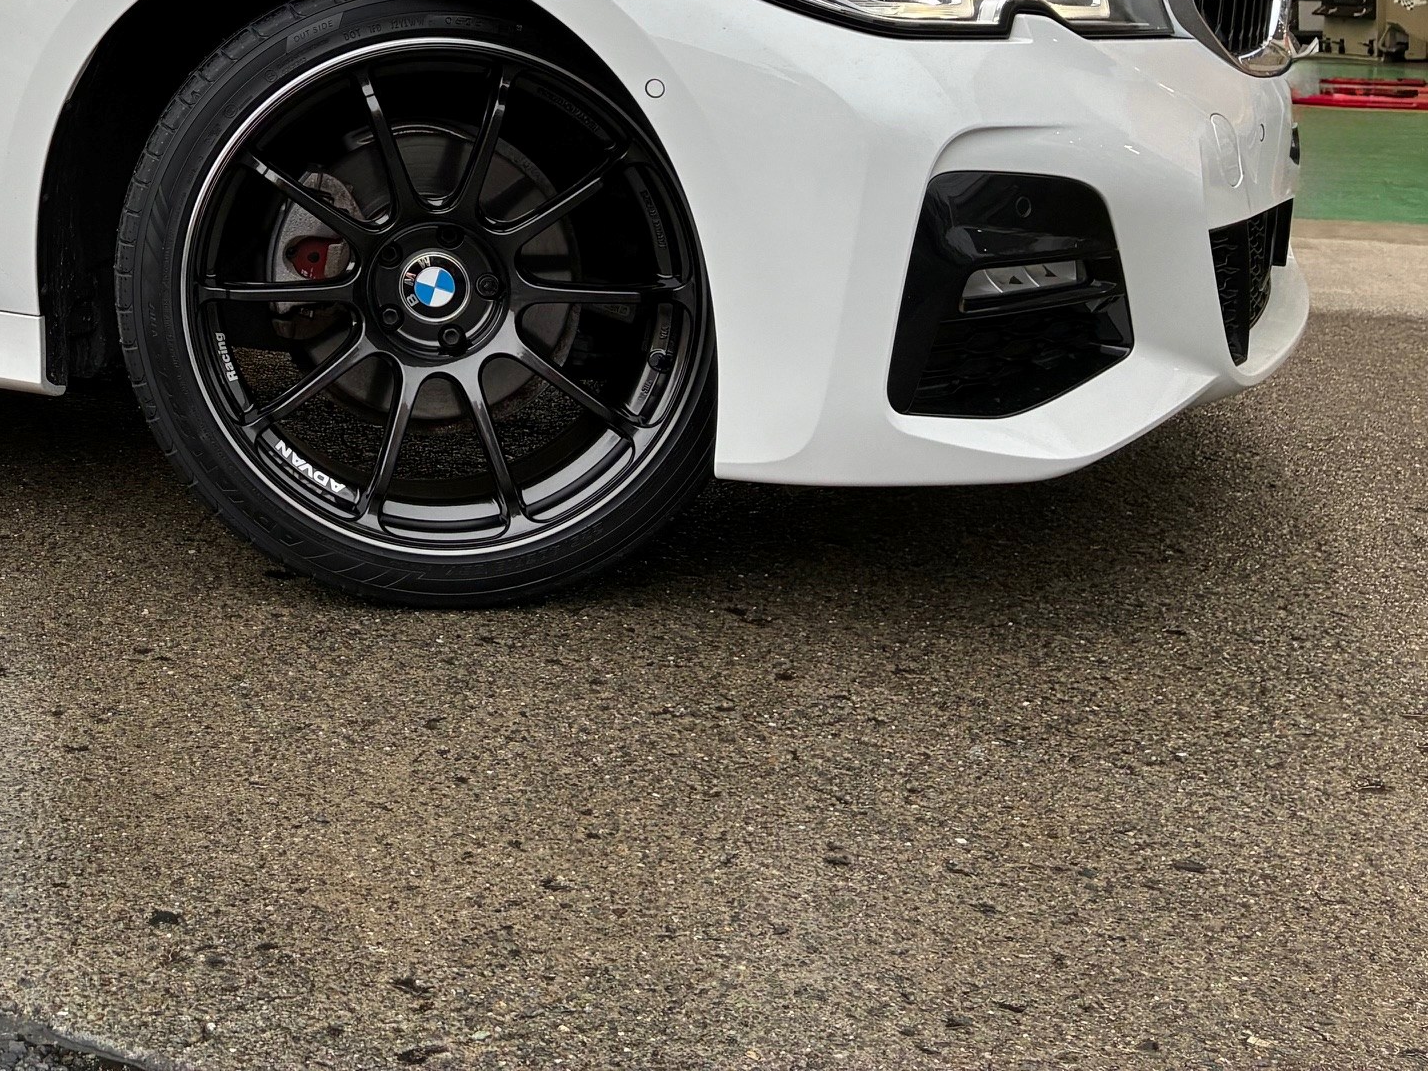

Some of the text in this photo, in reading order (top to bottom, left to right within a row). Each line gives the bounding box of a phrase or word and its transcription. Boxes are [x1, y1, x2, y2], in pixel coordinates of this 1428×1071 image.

[293, 20, 334, 43] OUT SIDE
[215, 332, 239, 382] Racing
[275, 439, 346, 494] ADVAN
